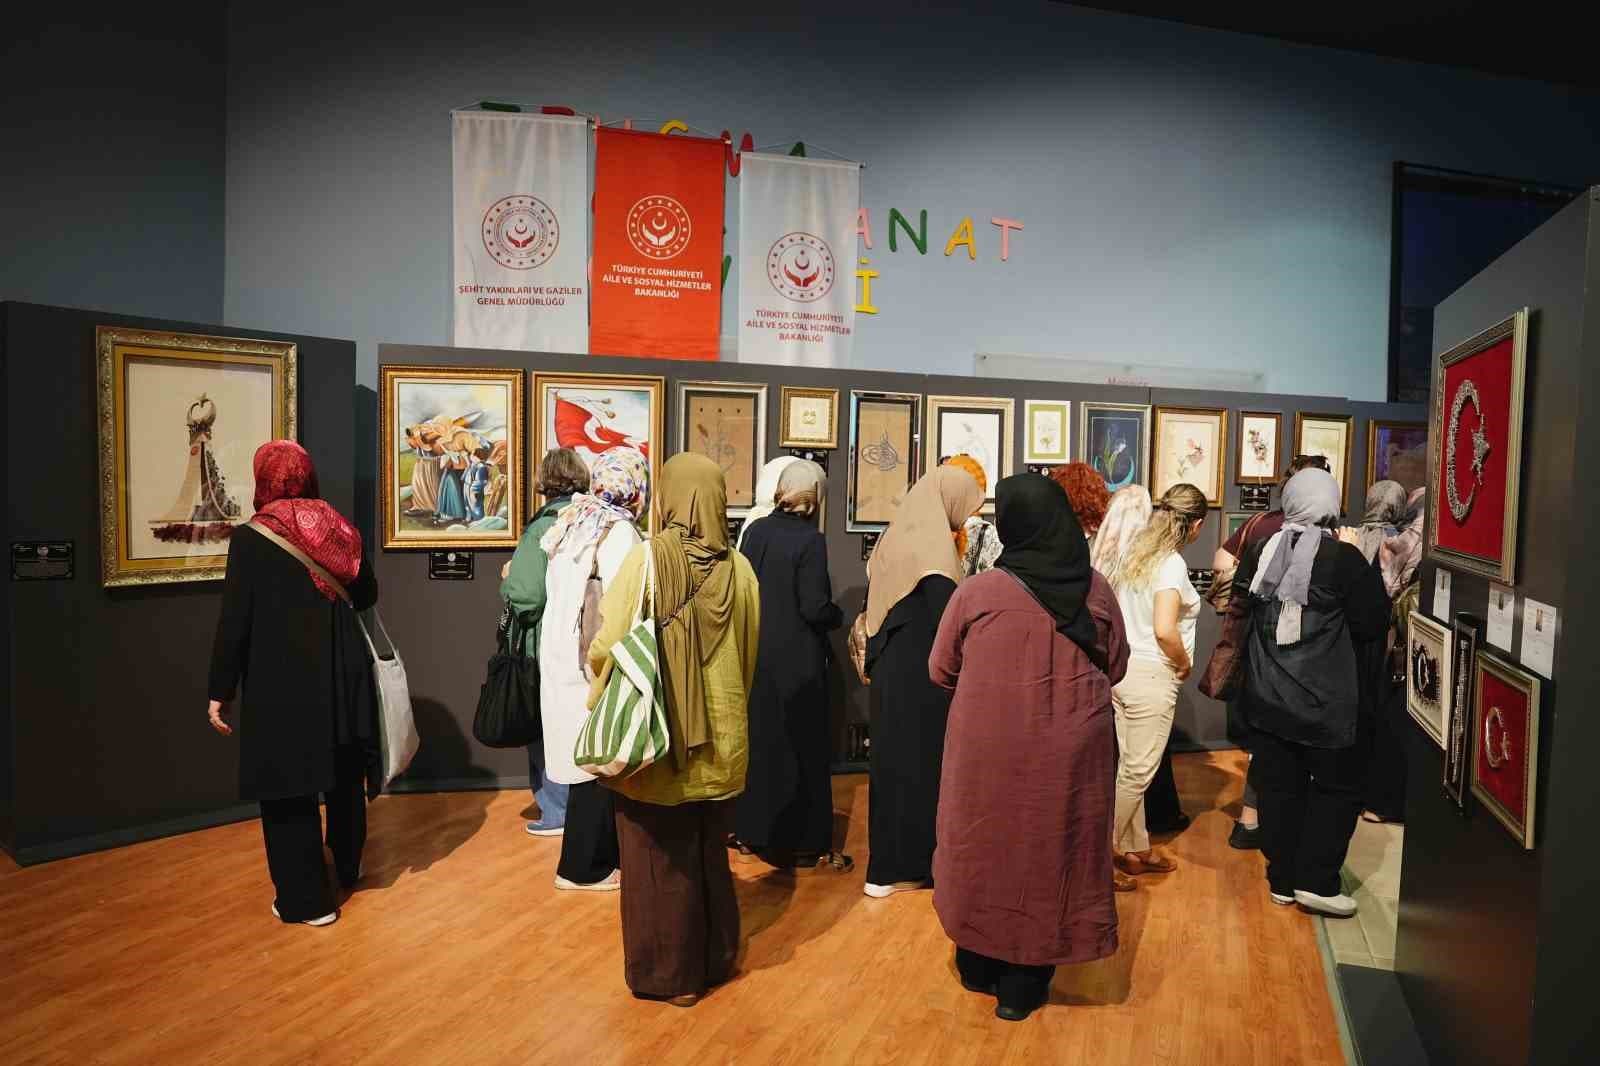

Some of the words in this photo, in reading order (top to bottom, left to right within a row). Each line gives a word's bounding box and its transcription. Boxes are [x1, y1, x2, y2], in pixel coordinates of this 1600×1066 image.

[611, 264, 645, 275] TÜRKİYE
[647, 267, 703, 280] CUMHURİYETİ
[602, 273, 620, 284] AİLE
[622, 276, 633, 285] VE
[634, 277, 665, 287] SOSYAL
[666, 279, 712, 291] HİZMETLER
[458, 284, 484, 294] ŞEHİT
[486, 285, 532, 295] YAKINLARI
[532, 286, 544, 295] VE
[546, 286, 582, 296] GAZİLER
[634, 287, 680, 299] BAKANLIĞI
[476, 297, 504, 305] GENEL
[507, 296, 565, 306] MÜDÜRLÜĞÜ
[755, 308, 790, 319] TÜRKİYE
[791, 311, 844, 324] CUMHURİYETİ
[745, 318, 765, 329] AİLE
[766, 321, 776, 329] VE
[778, 322, 808, 331] SOSYAL
[778, 332, 824, 343] BAKANLIĞI
